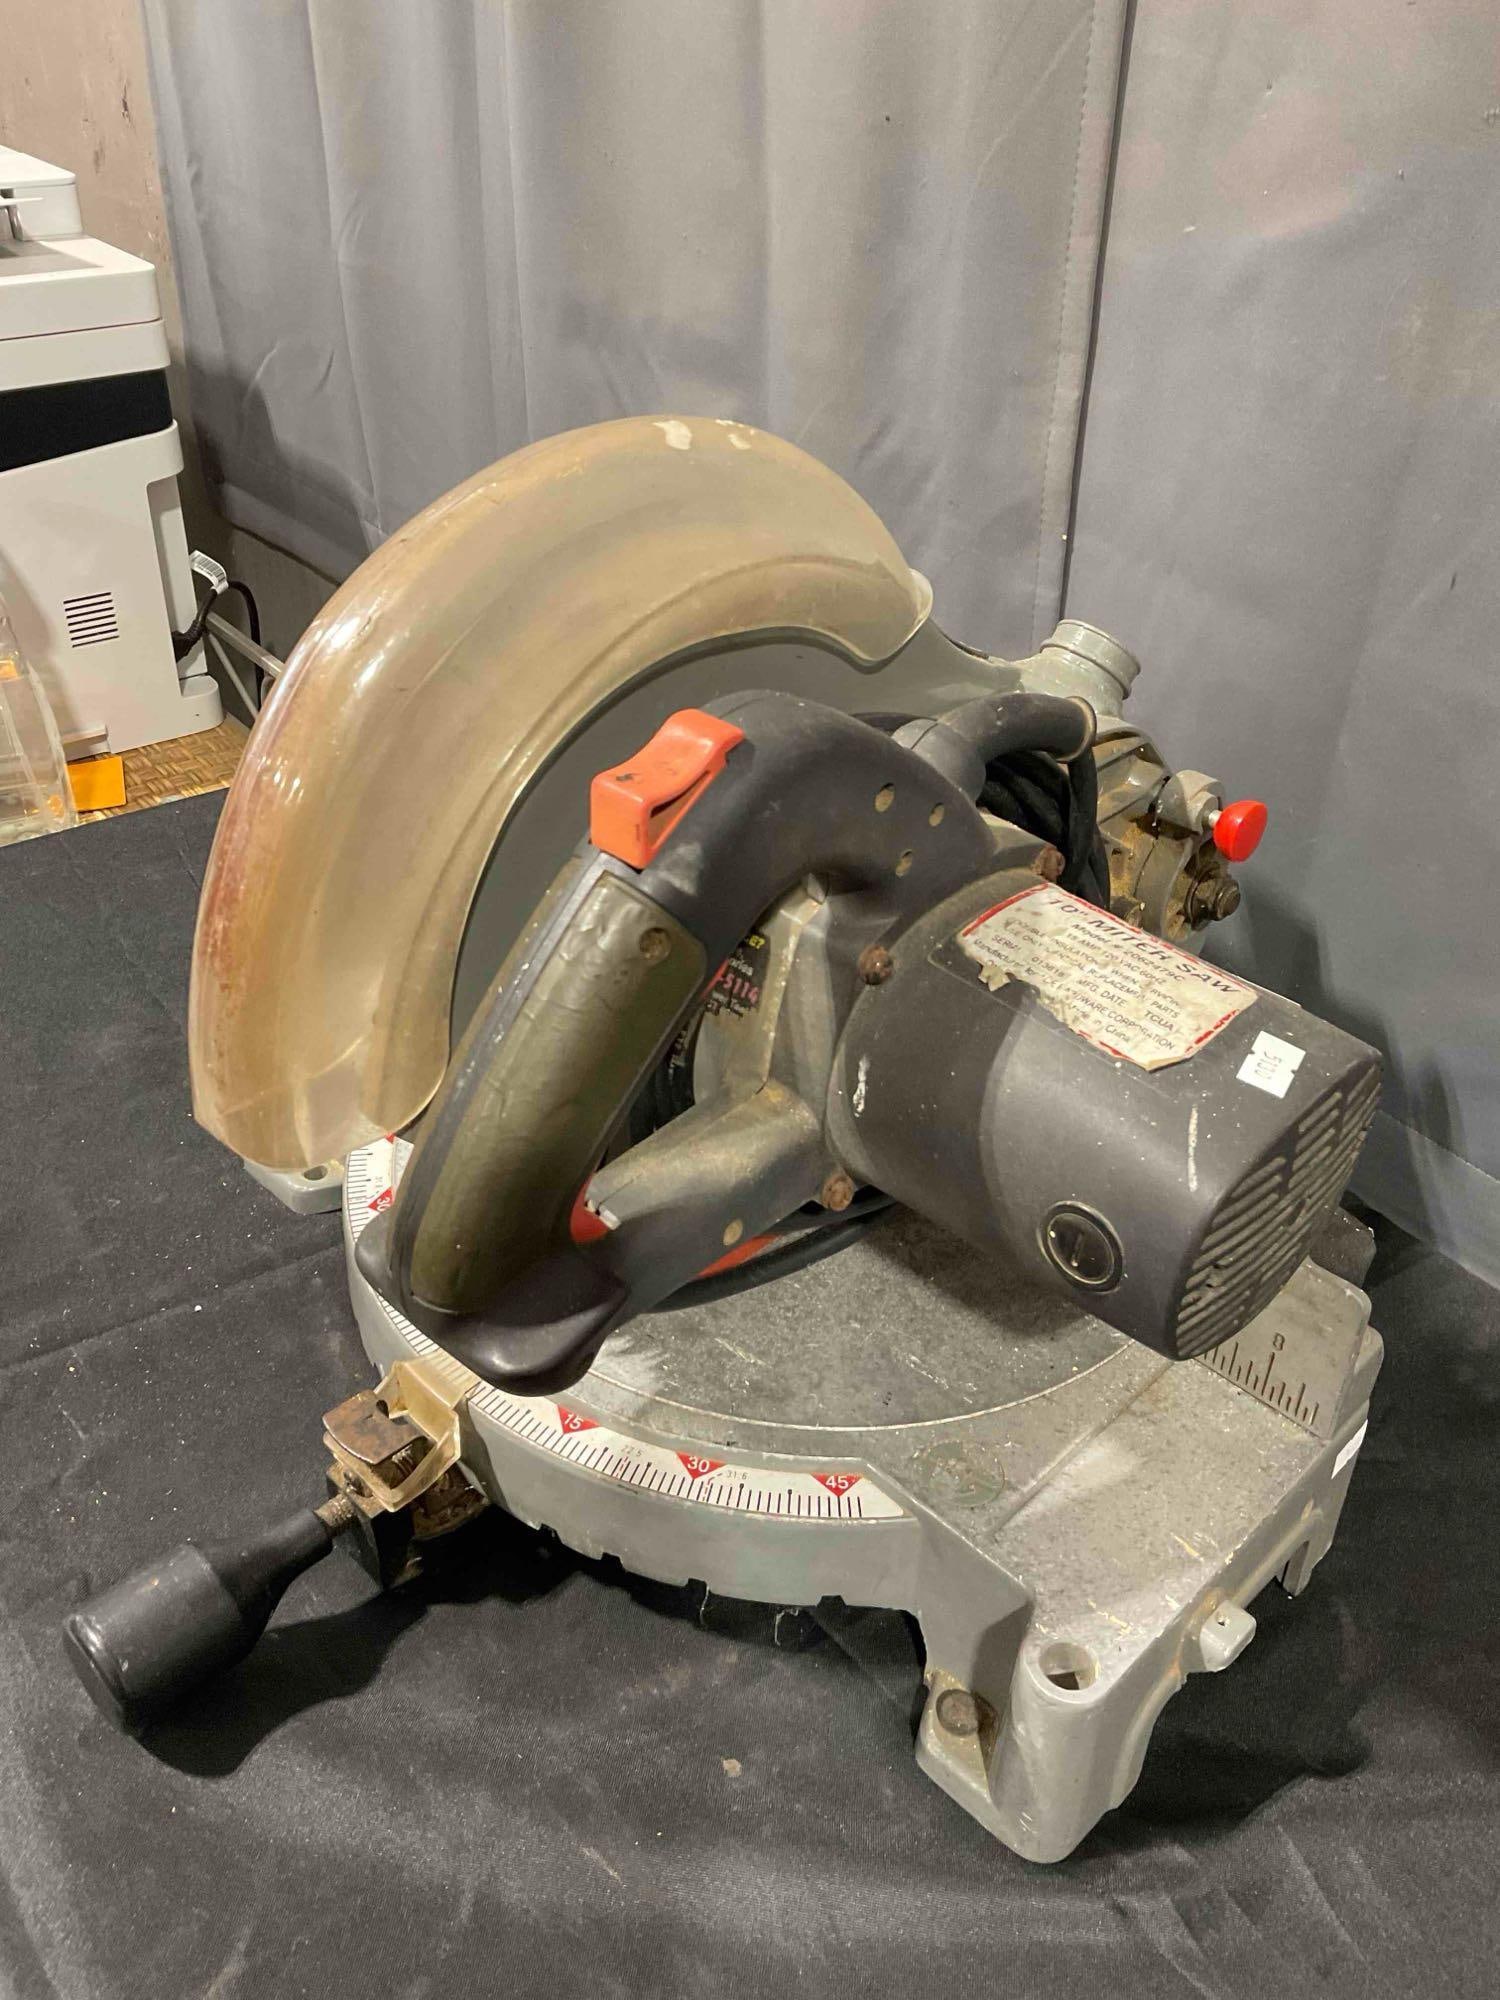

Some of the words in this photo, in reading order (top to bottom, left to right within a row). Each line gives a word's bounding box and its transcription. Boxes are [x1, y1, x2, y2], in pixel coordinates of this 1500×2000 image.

[1071, 923, 1112, 945] Model
[1089, 918, 1173, 961] MITER
[1176, 963, 1242, 994] SAW
[1151, 1000, 1182, 1019] PARTS
[563, 1412, 585, 1430] 15
[687, 1455, 711, 1474] 30
[825, 1474, 850, 1490] 45
